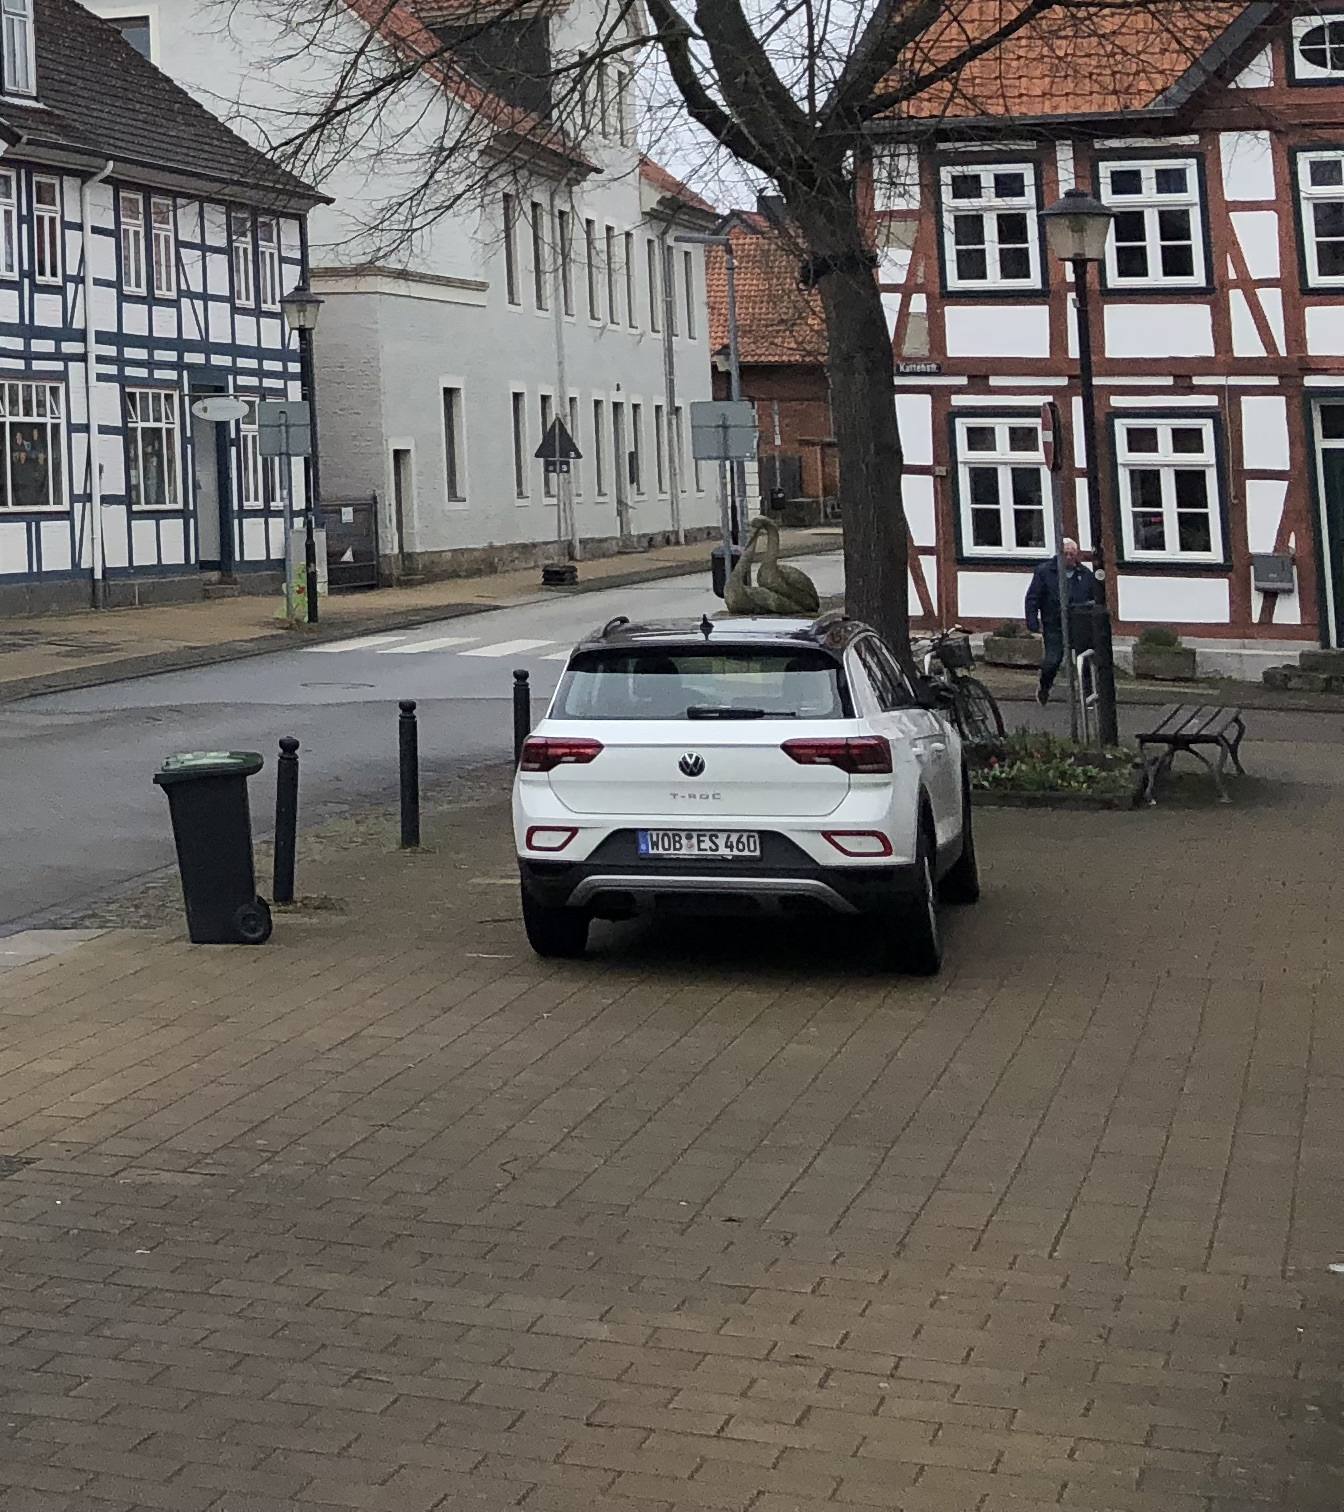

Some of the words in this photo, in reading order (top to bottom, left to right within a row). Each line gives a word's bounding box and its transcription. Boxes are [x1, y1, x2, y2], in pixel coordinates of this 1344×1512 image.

[669, 792, 722, 800] T-ROC
[649, 832, 683, 852] WOB
[696, 833, 720, 852] ES
[724, 834, 757, 853] 460
